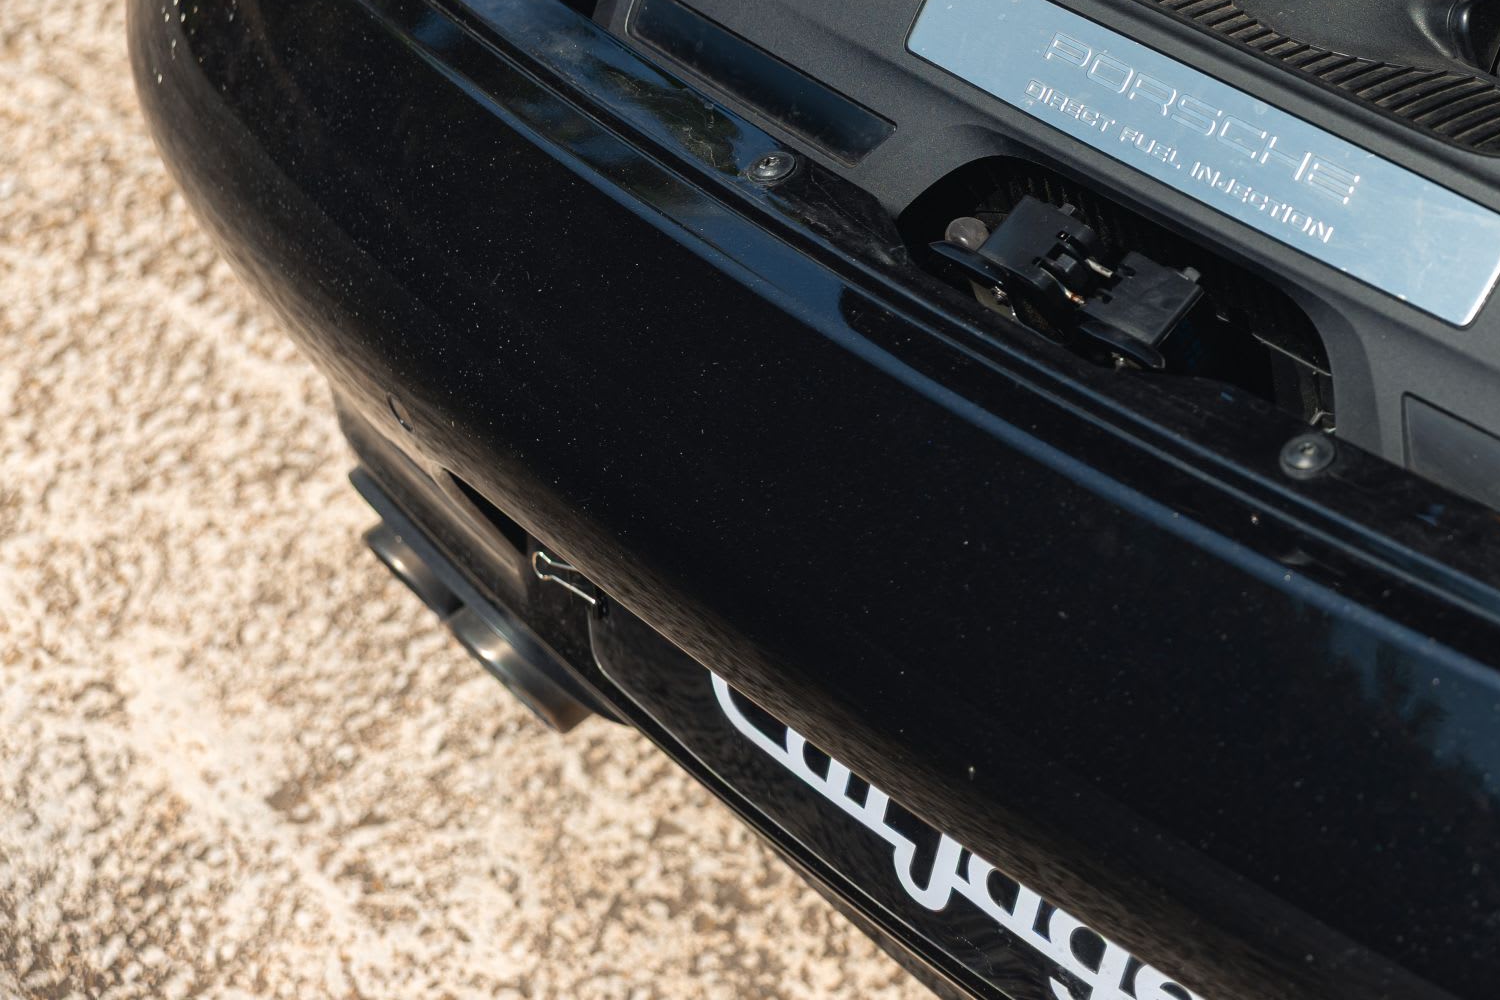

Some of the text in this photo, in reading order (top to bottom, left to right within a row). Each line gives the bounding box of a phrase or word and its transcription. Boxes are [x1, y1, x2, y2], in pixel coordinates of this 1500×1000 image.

[1024, 79, 1334, 243] DIRECT FUEL INJECTION
[1043, 32, 1361, 205] PORSCHE
